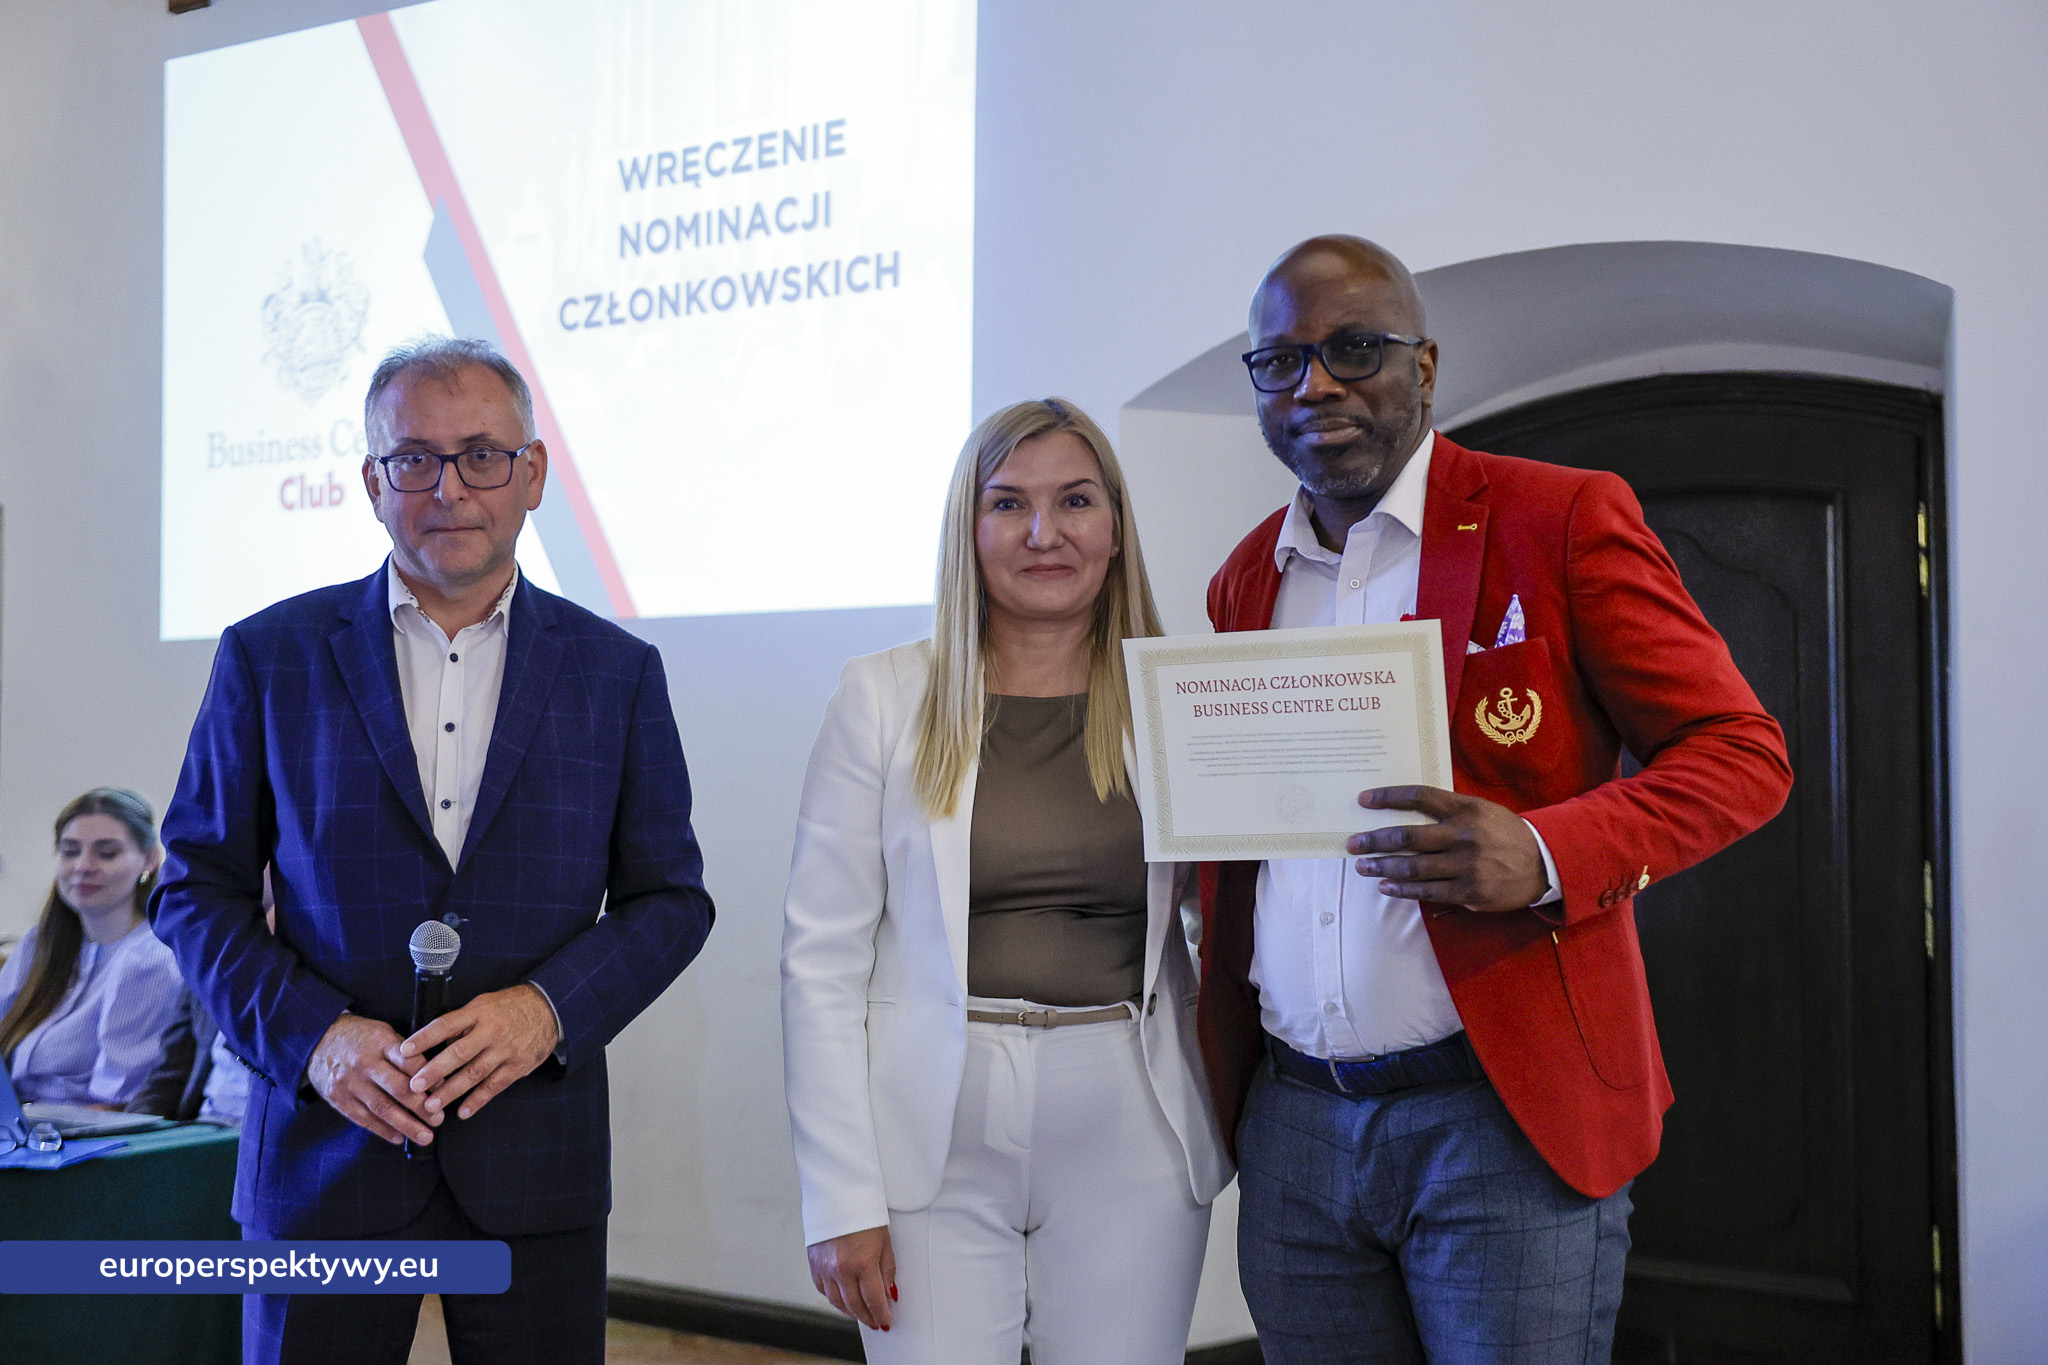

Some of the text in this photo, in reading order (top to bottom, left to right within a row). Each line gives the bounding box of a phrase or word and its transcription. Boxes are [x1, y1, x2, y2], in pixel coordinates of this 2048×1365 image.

[617, 118, 846, 193] WRĘCZENIE
[619, 190, 832, 259] NOMINACJI
[559, 250, 900, 331] CZŁONKOWSKICH
[207, 429, 323, 469] Business
[280, 471, 345, 511] Club
[1175, 670, 1397, 695] NOMINACJA CZŁONKOWSKA
[1193, 696, 1382, 718] BUSINESS CENTRE CLUB
